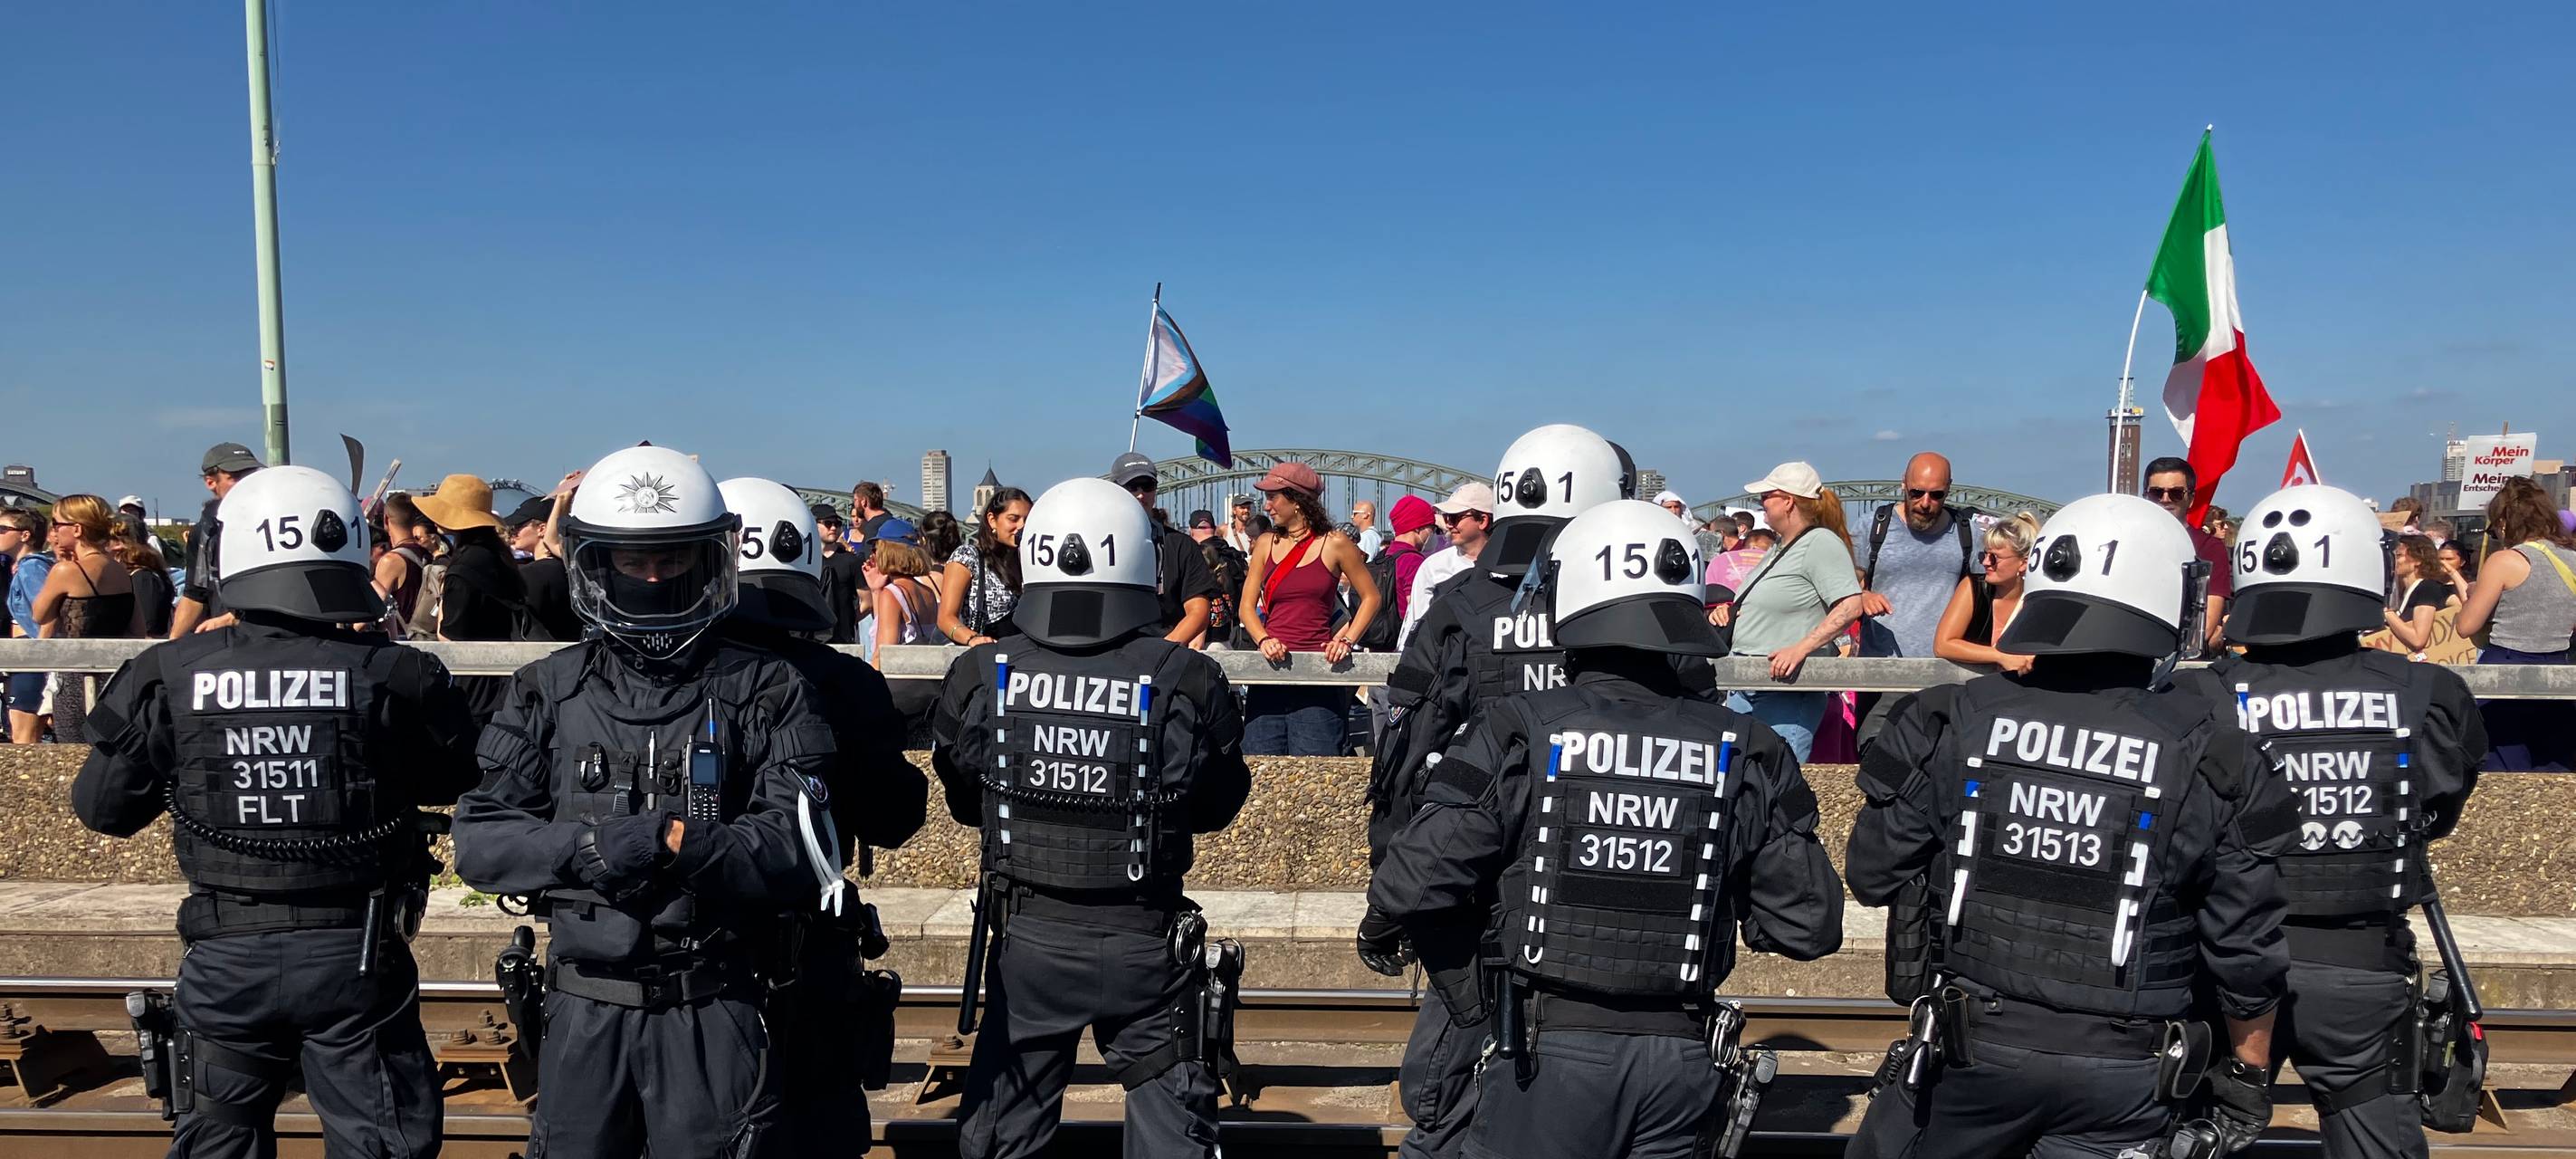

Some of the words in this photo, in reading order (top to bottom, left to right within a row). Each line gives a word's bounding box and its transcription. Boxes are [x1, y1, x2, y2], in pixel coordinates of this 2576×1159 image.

[2475, 456, 2516, 467] Körper
[2492, 446, 2529, 457] Mein
[1495, 471, 1514, 504] 15
[1558, 472, 1572, 503] 1
[2463, 484, 2504, 493] Entschei
[2472, 473, 2511, 484] Mein
[256, 516, 303, 551] 15
[350, 516, 362, 549] 1
[741, 527, 764, 559] 5
[804, 532, 813, 564] 1
[1028, 533, 1054, 566] 15
[1101, 534, 1115, 566] 1
[1596, 543, 1647, 581] 15
[1692, 549, 1701, 585] 1
[2097, 540, 2119, 576] 1
[2236, 541, 2256, 575] 15
[2314, 535, 2330, 569] 1
[1493, 614, 1553, 649] POL
[193, 671, 347, 710] POLIZEI
[1006, 672, 1140, 716] POLIZEI
[1523, 664, 1567, 691] NR
[2247, 692, 2399, 733] POLIZEI
[225, 725, 311, 755] NRW
[1034, 724, 1111, 758] NRW
[1987, 717, 2159, 783] POLIZEI
[233, 760, 318, 790] 31511
[1560, 732, 1714, 785] POLIZEI
[2285, 752, 2371, 781] NRW
[1029, 760, 1107, 793] 31512
[238, 794, 305, 824] FLT
[1588, 791, 1678, 829] NRW
[2008, 782, 2106, 827] NRW
[2291, 785, 2372, 816] 1512
[1579, 834, 1673, 873] 31512
[2003, 822, 2101, 867] 31513
